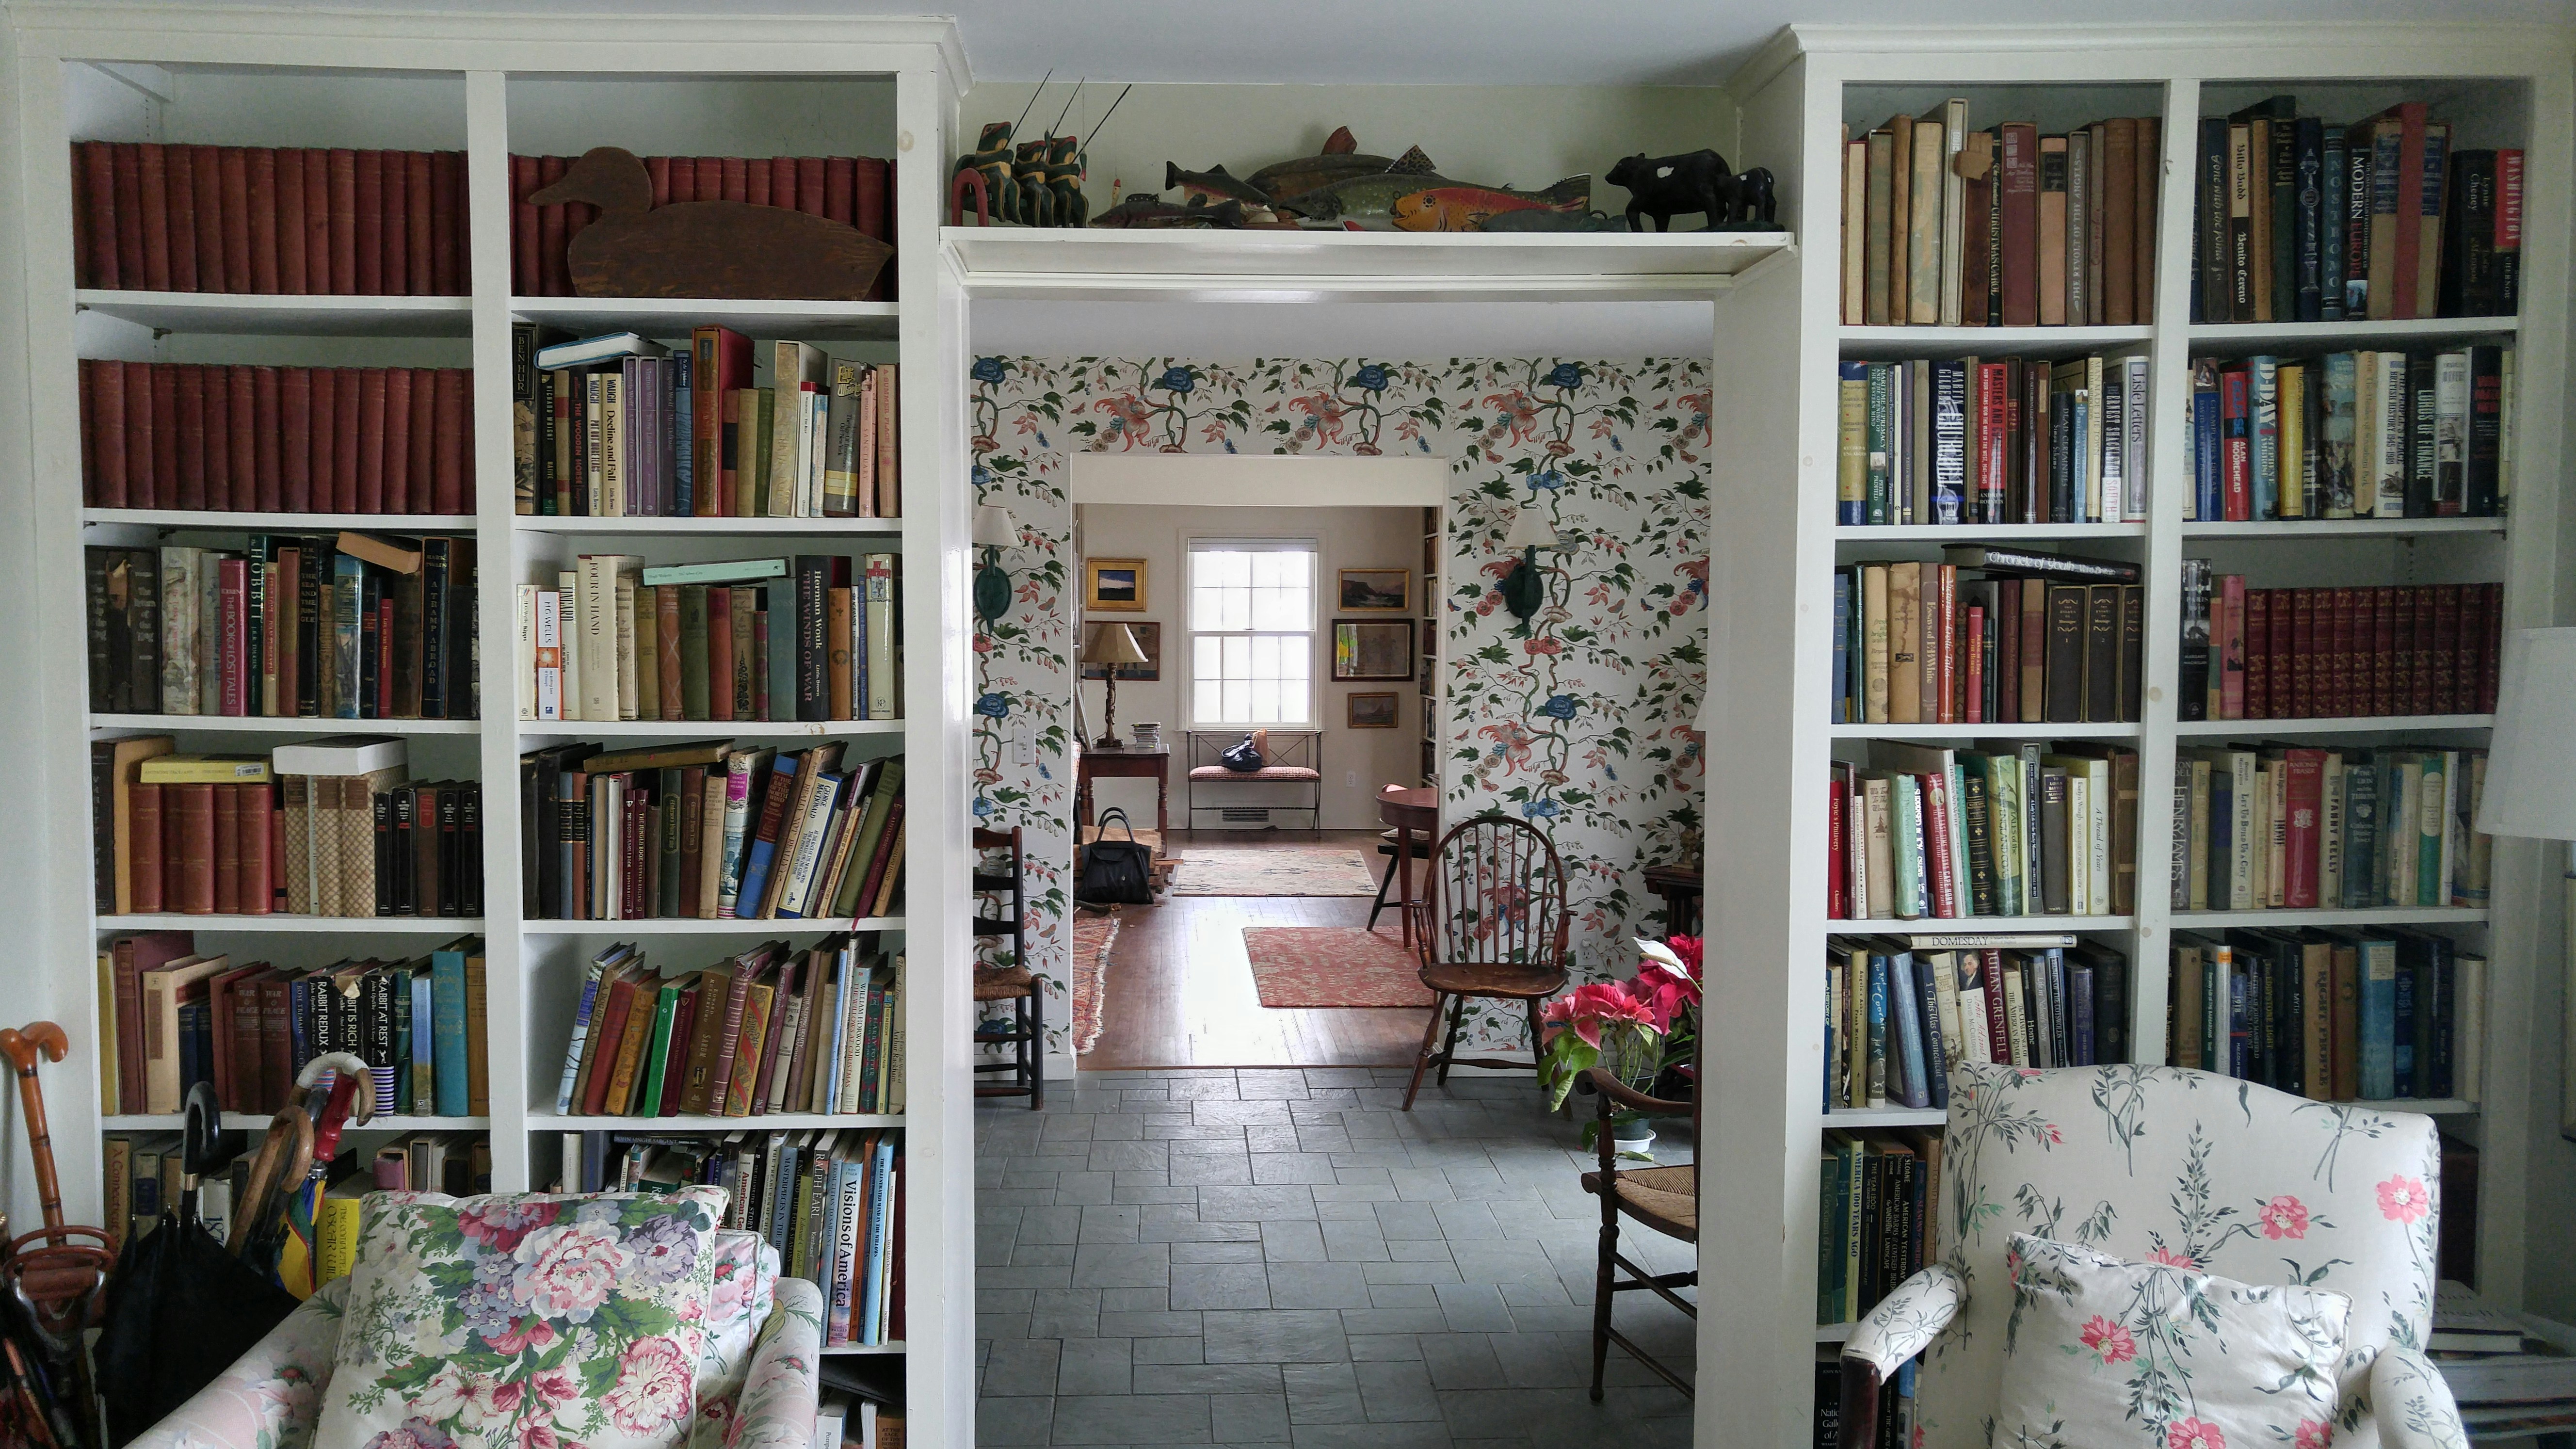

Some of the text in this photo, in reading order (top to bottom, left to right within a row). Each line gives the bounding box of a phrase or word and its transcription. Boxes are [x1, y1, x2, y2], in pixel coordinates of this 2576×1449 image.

[2073, 160, 2081, 198] ANGELS
[2073, 224, 2081, 237] OF
[2234, 144, 2248, 304] Billy Budd Benito Cereno
[2350, 157, 2365, 275] MODERN EUROPE
[1990, 207, 1999, 296] CHRISTMAS CAROL
[1938, 369, 1951, 405] GILBERT
[1952, 370, 1964, 405] MARTIN
[1992, 369, 2003, 424] MASTERS AND
[2131, 373, 2145, 443] Lisle Letters
[2232, 381, 2245, 435] ECLIPSE
[2259, 362, 2276, 428] D-DAY
[2386, 371, 2398, 432] BRITISH HISTORY
[589, 380, 600, 472] WAUGH PUT OUT MORE FLAGS
[607, 379, 617, 481] WAUGH Decline and Fall
[1937, 412, 1964, 487] CHURCHILL
[2416, 389, 2434, 480] LORDS OF FINANCE
[575, 459, 583, 484] HORSE
[2105, 395, 2120, 513] ERNEST SHACKLETON SOUTH
[226, 596, 235, 611] THE
[589, 563, 600, 635] FOUR IN HAND
[226, 611, 236, 640] BOOK
[803, 571, 813, 702] THE WINDS OF WAR
[815, 618, 823, 649] Wouk
[1926, 601, 1936, 684] Essays of White
[1944, 578, 1954, 677] Victorian Erotic Tales
[226, 650, 236, 677] LOST
[226, 677, 237, 705] TALES
[820, 786, 831, 807] GEORGE
[781, 784, 811, 868] REALLY NOT REALLY
[2273, 820, 2286, 846] HOME
[2329, 799, 2339, 873] FANNY KELLY
[1942, 871, 1953, 905] CAPE HORN
[1932, 937, 1989, 946] DOMESDAY
[317, 982, 328, 1046] RABBIT REDUX
[378, 981, 388, 1046] RABBIT AT REST
[854, 983, 867, 1057] WILLIAM HORWOOD
[1974, 996, 1984, 1018] John
[1986, 951, 2008, 1055] JULIAN GRENFELL
[2010, 1004, 2019, 1037] AMERICAN
[347, 1024, 357, 1046] RICH
[699, 1034, 711, 1058] SARUM
[849, 1036, 856, 1046] AT
[1926, 991, 1943, 1077] This Was Connecticut
[2027, 1019, 2035, 1045] Home
[2315, 971, 2327, 1086] RIGHT PEOPLE
[845, 1049, 855, 1088] CHRISTMAS
[891, 1030, 900, 1082] Arthur Rackham
[737, 1172, 749, 1215] American
[778, 1158, 791, 1210] MASTERPIECES
[813, 1154, 825, 1188] RALPH
[1854, 1151, 1863, 1190] AMERICA
[326, 1206, 337, 1250] OSCAR
[746, 1207, 755, 1230] STORY
[810, 1192, 823, 1219] EARL
[1852, 1209, 1860, 1237] YEARS
[835, 1180, 857, 1307] Visions of America
